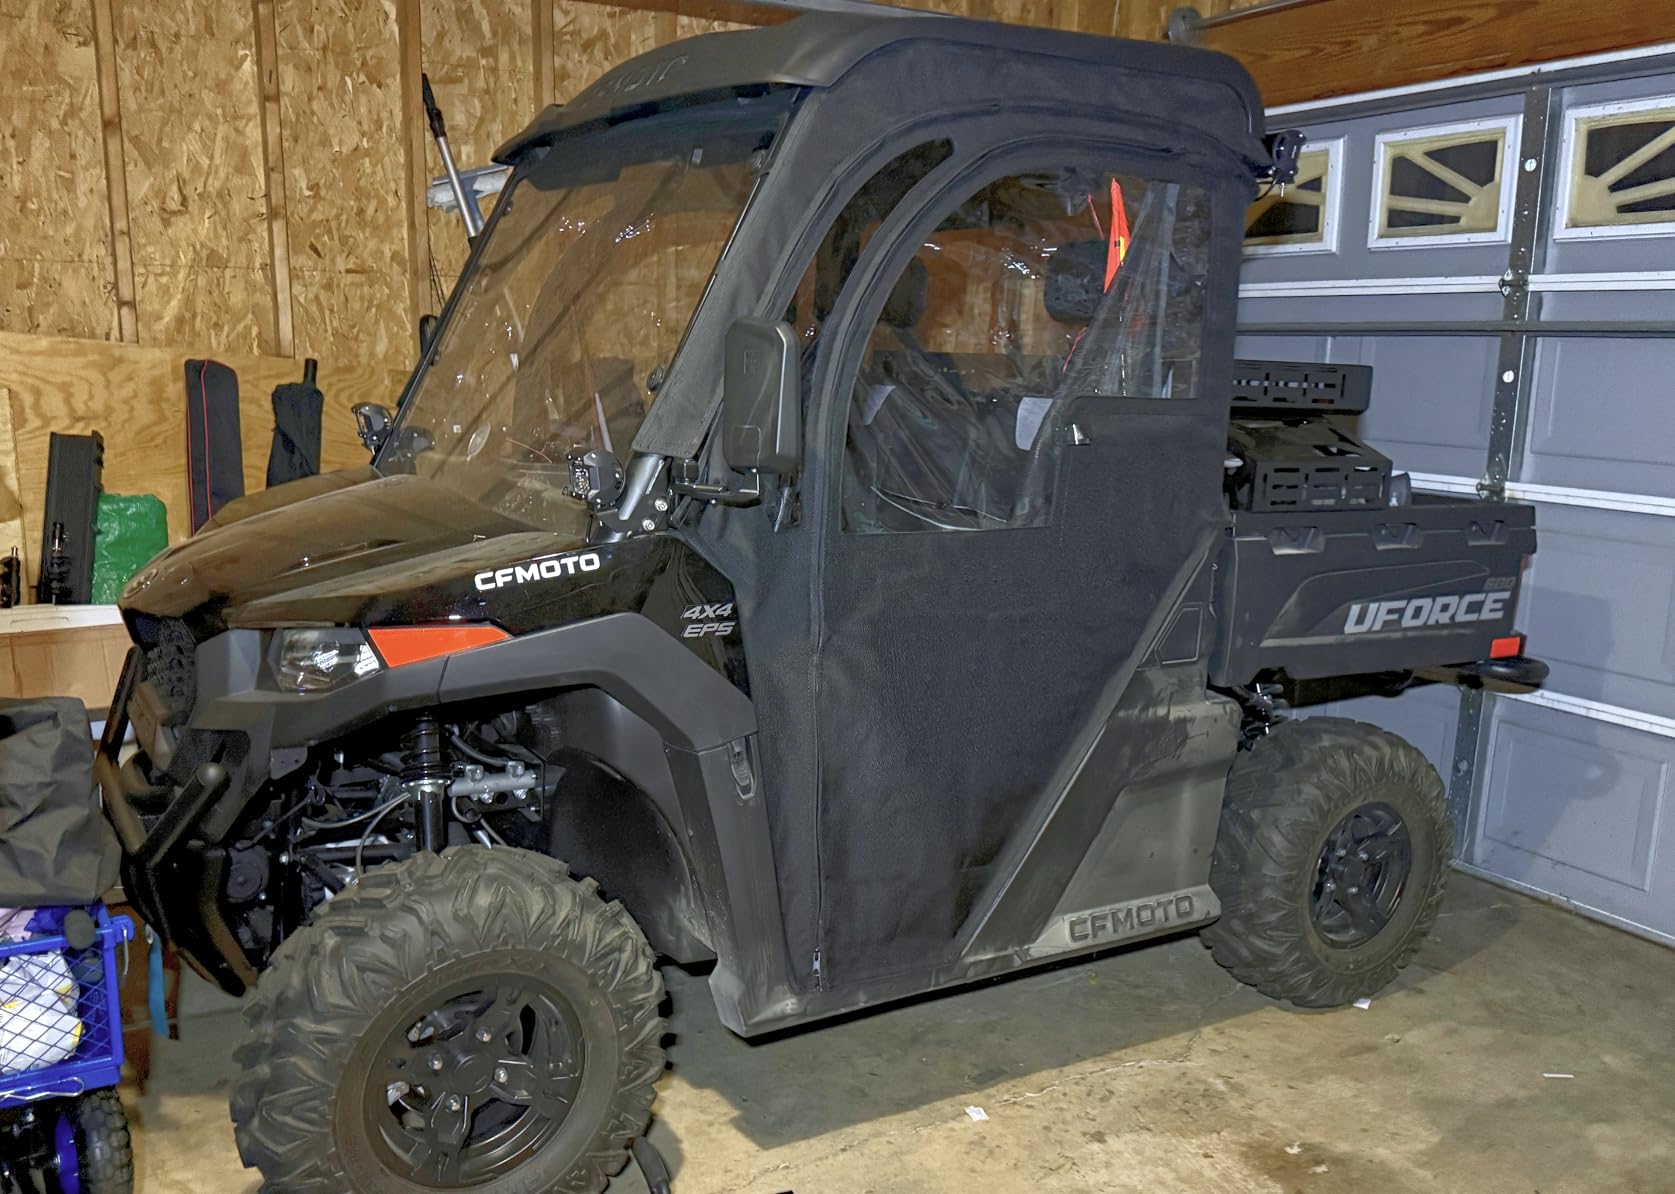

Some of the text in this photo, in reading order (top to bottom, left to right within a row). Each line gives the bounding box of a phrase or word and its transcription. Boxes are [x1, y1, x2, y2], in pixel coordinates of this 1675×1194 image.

[474, 553, 601, 591] CFMOTO
[681, 602, 735, 620] 4X4
[681, 621, 736, 638] EPS
[1343, 591, 1512, 635] UFORCE
[1069, 894, 1194, 942] CFMOTO
